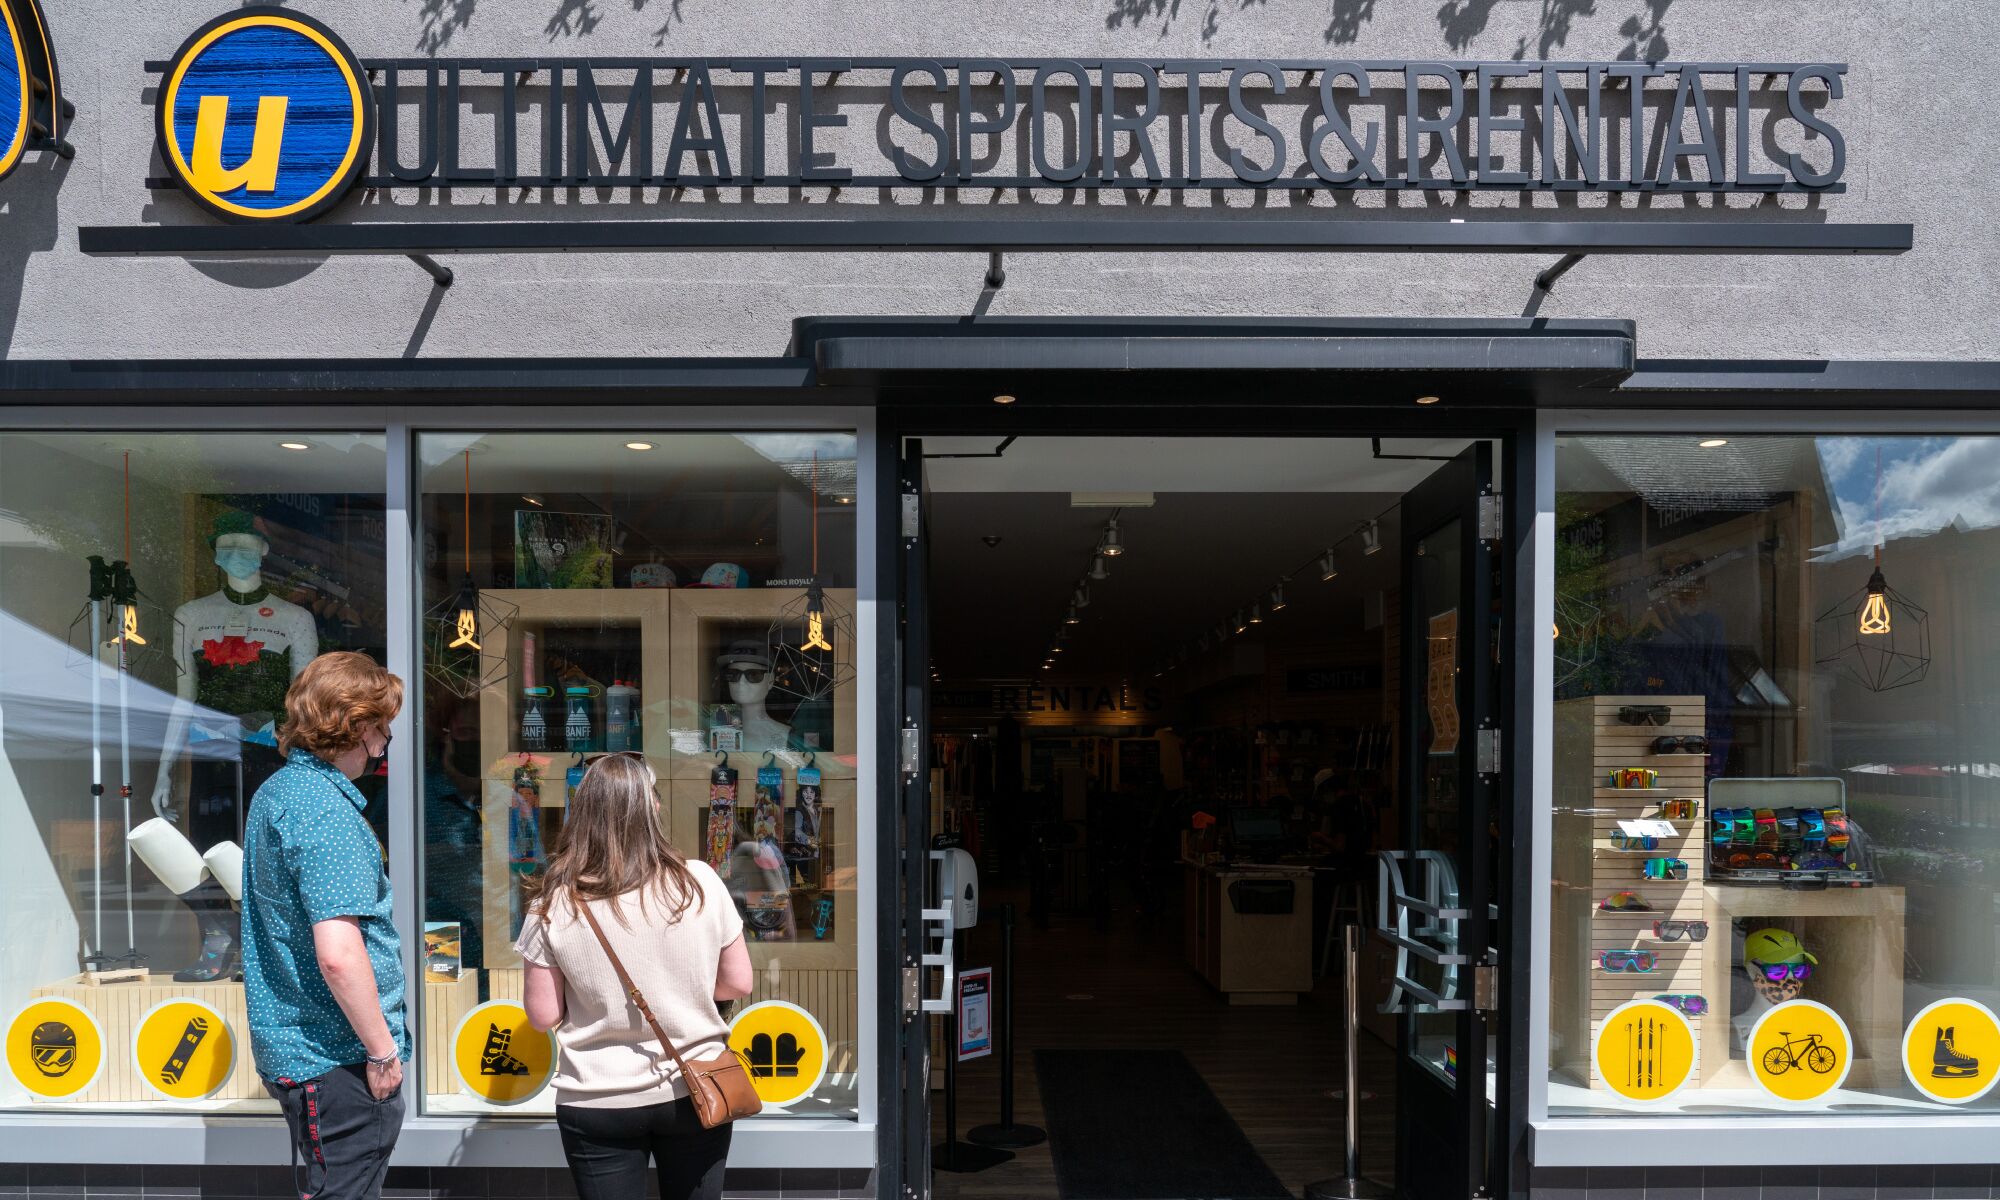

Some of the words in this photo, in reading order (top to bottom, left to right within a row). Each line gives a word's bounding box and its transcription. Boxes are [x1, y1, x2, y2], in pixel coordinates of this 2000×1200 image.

[382, 58, 852, 184] ULTIMATE
[889, 60, 1287, 186] SPORTS
[1308, 62, 1385, 185] &
[1404, 62, 1847, 189] RENTALS
[766, 579, 788, 587] MONS
[1305, 669, 1367, 689] SMITH
[1000, 686, 1163, 711] RENTALS
[522, 726, 547, 737] BANFF
[566, 726, 591, 737] BANFF
[608, 724, 626, 734] ANFF
